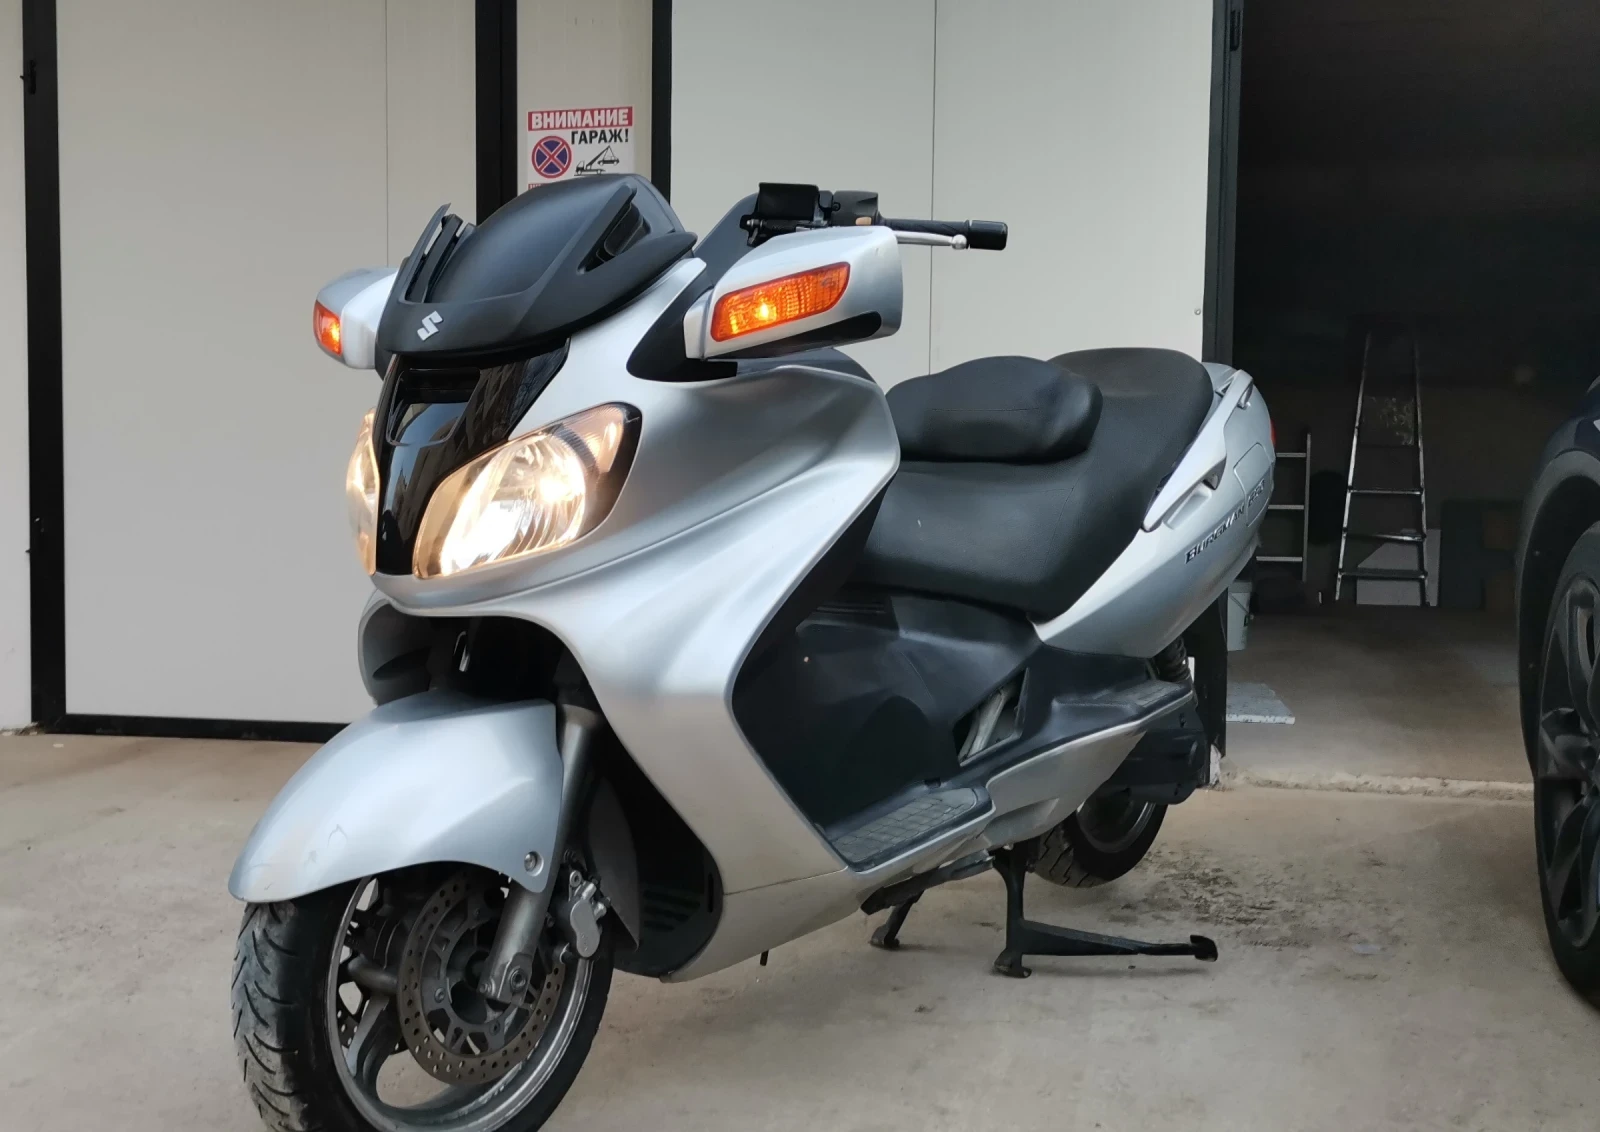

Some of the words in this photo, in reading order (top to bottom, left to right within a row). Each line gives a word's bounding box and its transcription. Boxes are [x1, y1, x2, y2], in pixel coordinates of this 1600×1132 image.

[531, 108, 629, 130] ВНИМАНИЕ
[571, 128, 629, 145] ГАРАЖ!
[1185, 502, 1245, 564] BURGMAN
